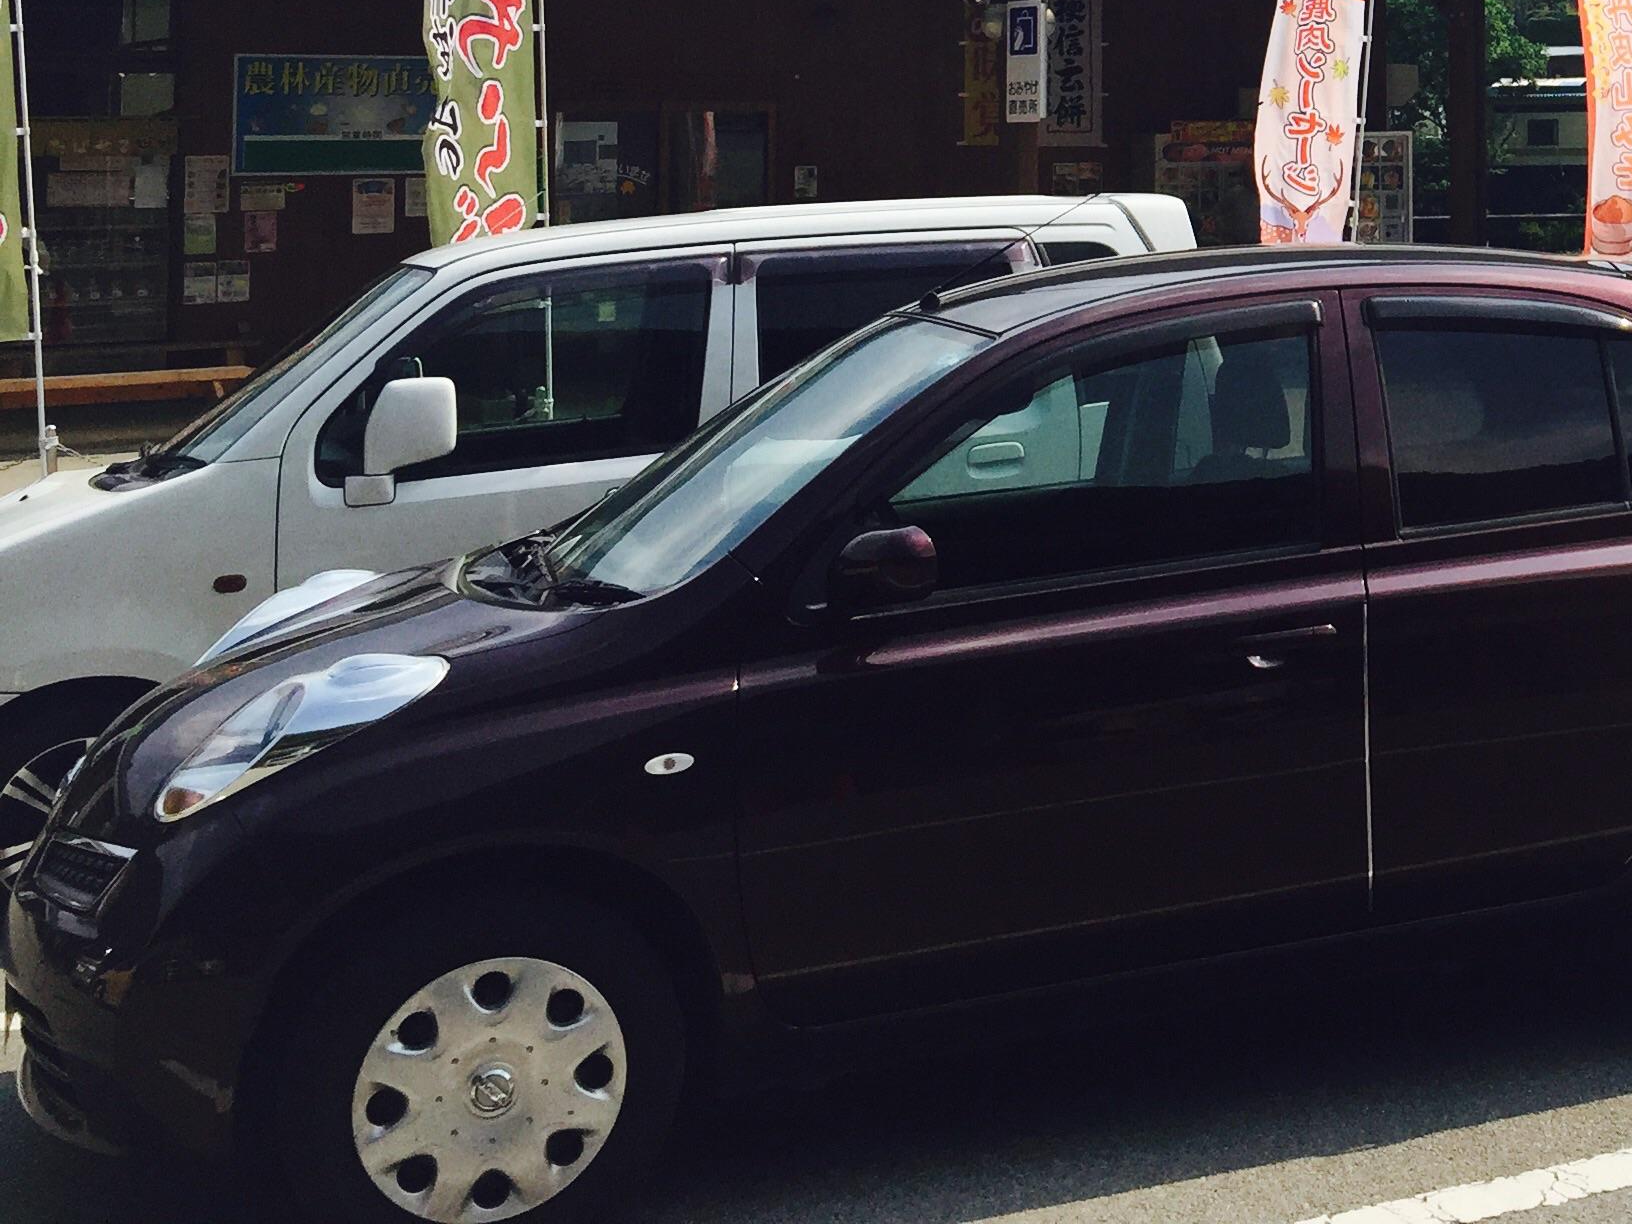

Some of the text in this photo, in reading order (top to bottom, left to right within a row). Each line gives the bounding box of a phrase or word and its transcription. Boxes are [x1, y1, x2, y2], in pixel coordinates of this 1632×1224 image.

[1008, 80, 1039, 96] おみやげ
[1008, 99, 1039, 115] 直売所
